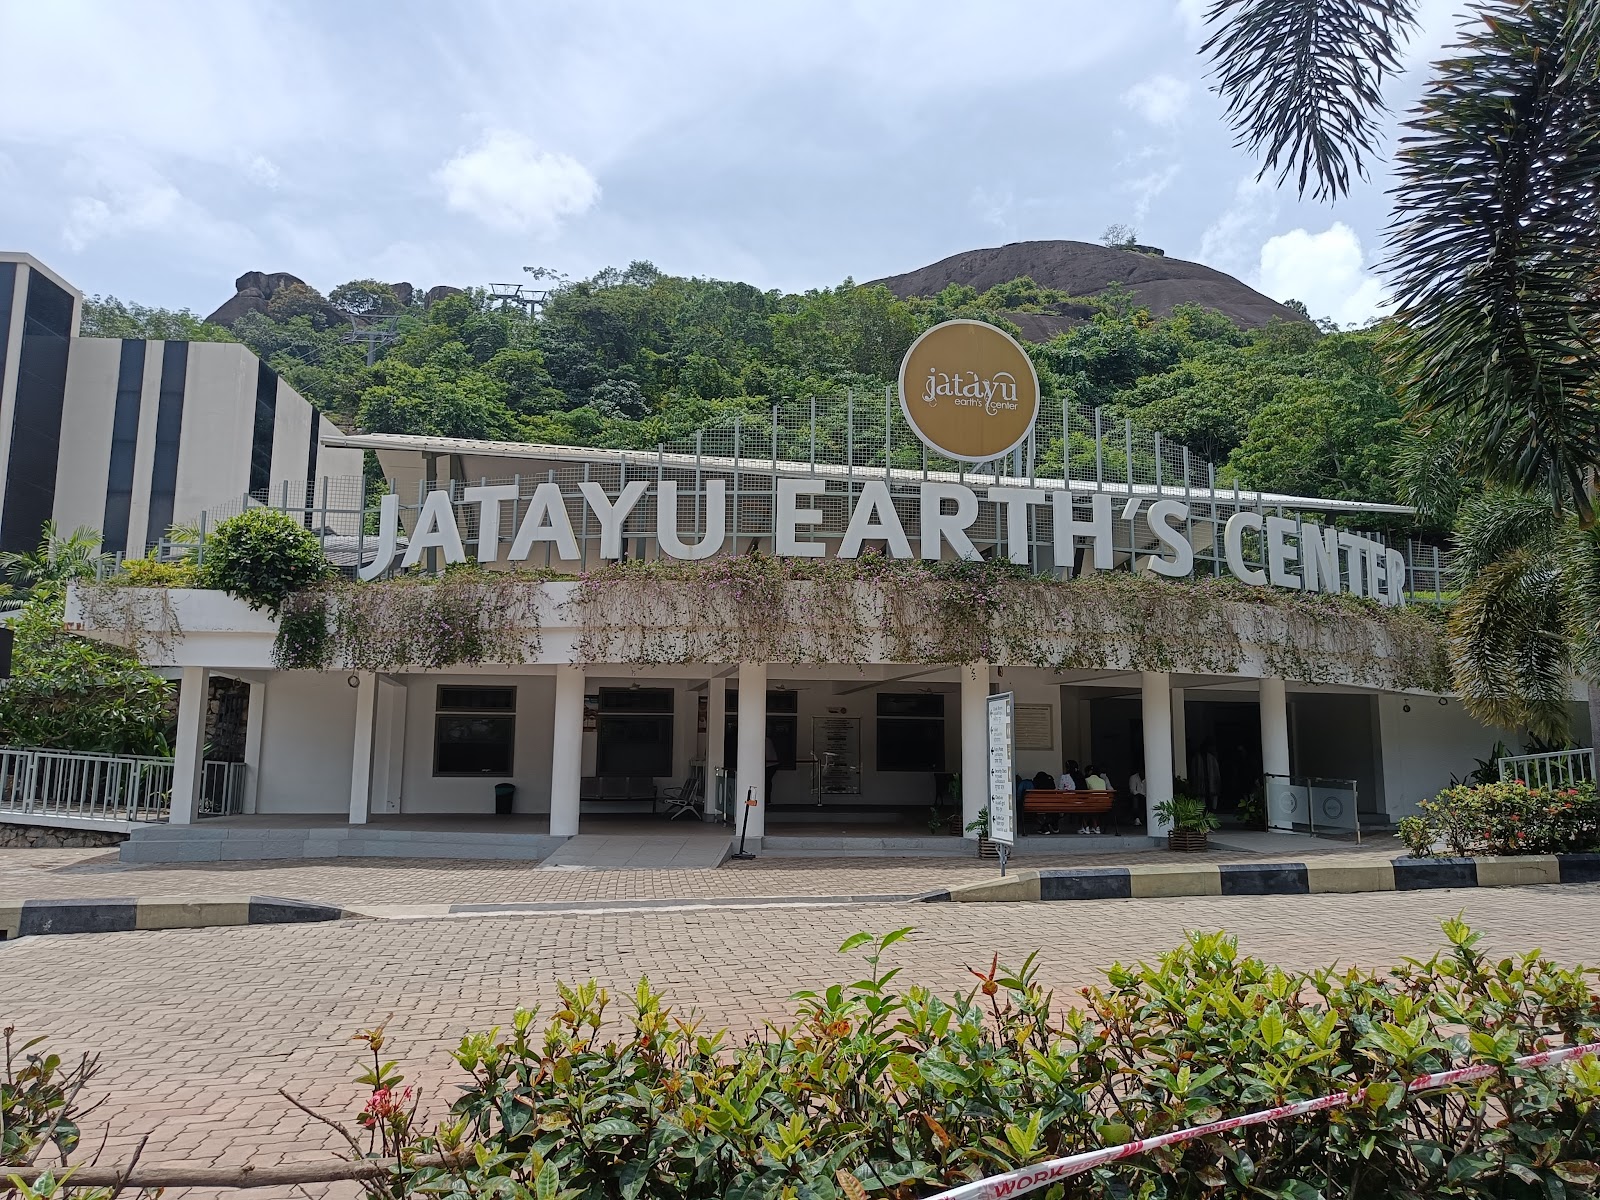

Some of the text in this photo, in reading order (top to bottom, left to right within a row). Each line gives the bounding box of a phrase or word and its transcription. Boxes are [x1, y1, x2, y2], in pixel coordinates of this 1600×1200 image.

[922, 367, 1018, 416] jatayu
[954, 398, 1018, 411] earth's center
[358, 478, 1406, 608] JATAYU EARTH'S CENTER
[994, 1164, 1066, 1198] WORK
